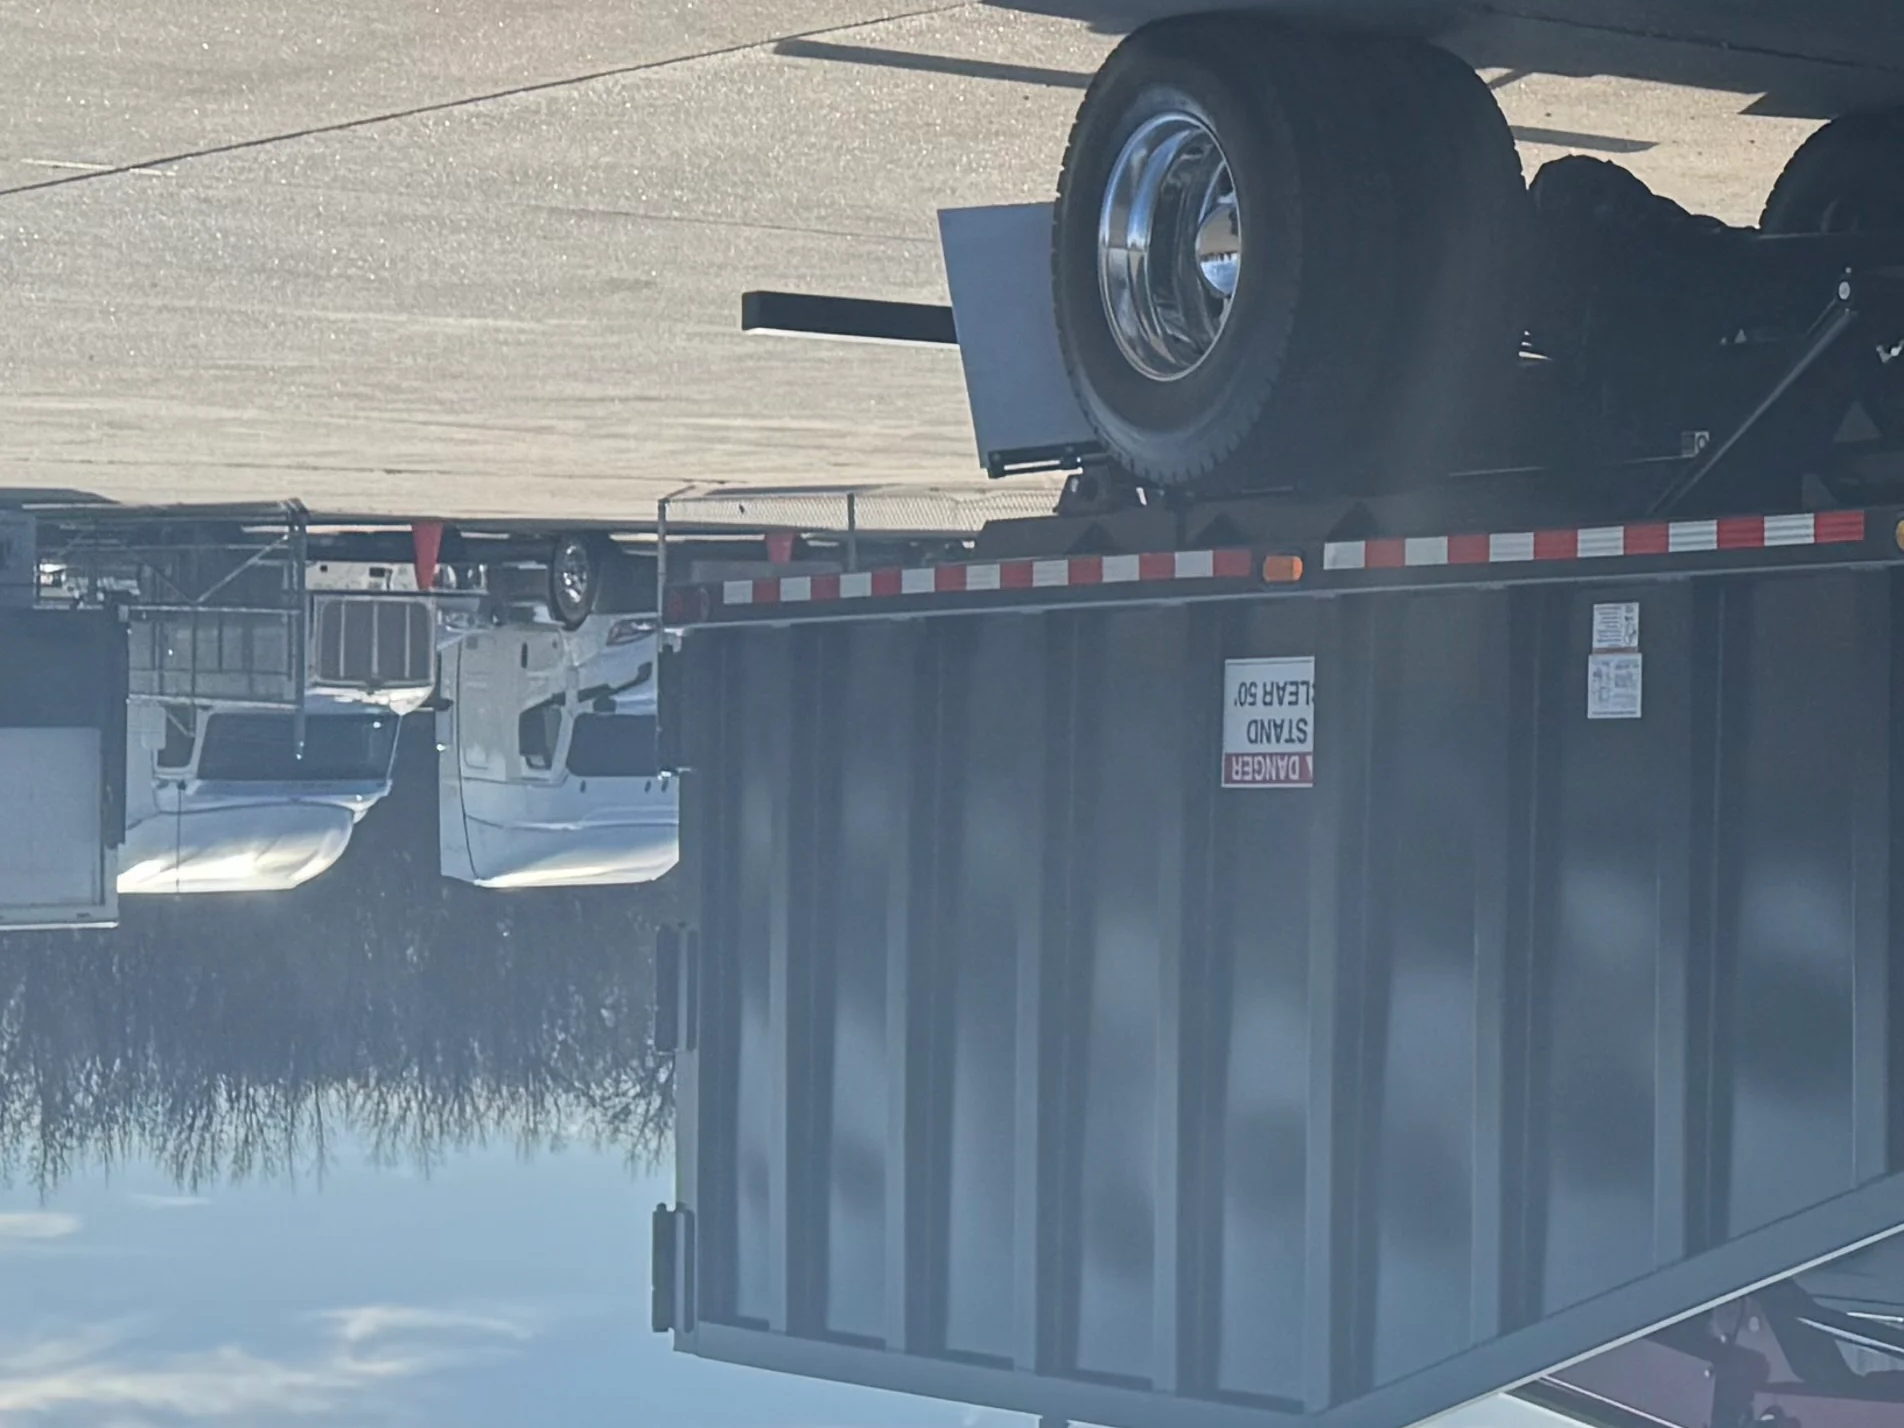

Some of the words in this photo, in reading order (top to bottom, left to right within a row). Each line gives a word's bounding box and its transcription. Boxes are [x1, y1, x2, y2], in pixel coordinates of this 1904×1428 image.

[1233, 681, 1258, 707] 50'
[1262, 680, 1315, 707] LEAR
[1246, 718, 1308, 745] STAND
[1231, 755, 1300, 781] DANGER
